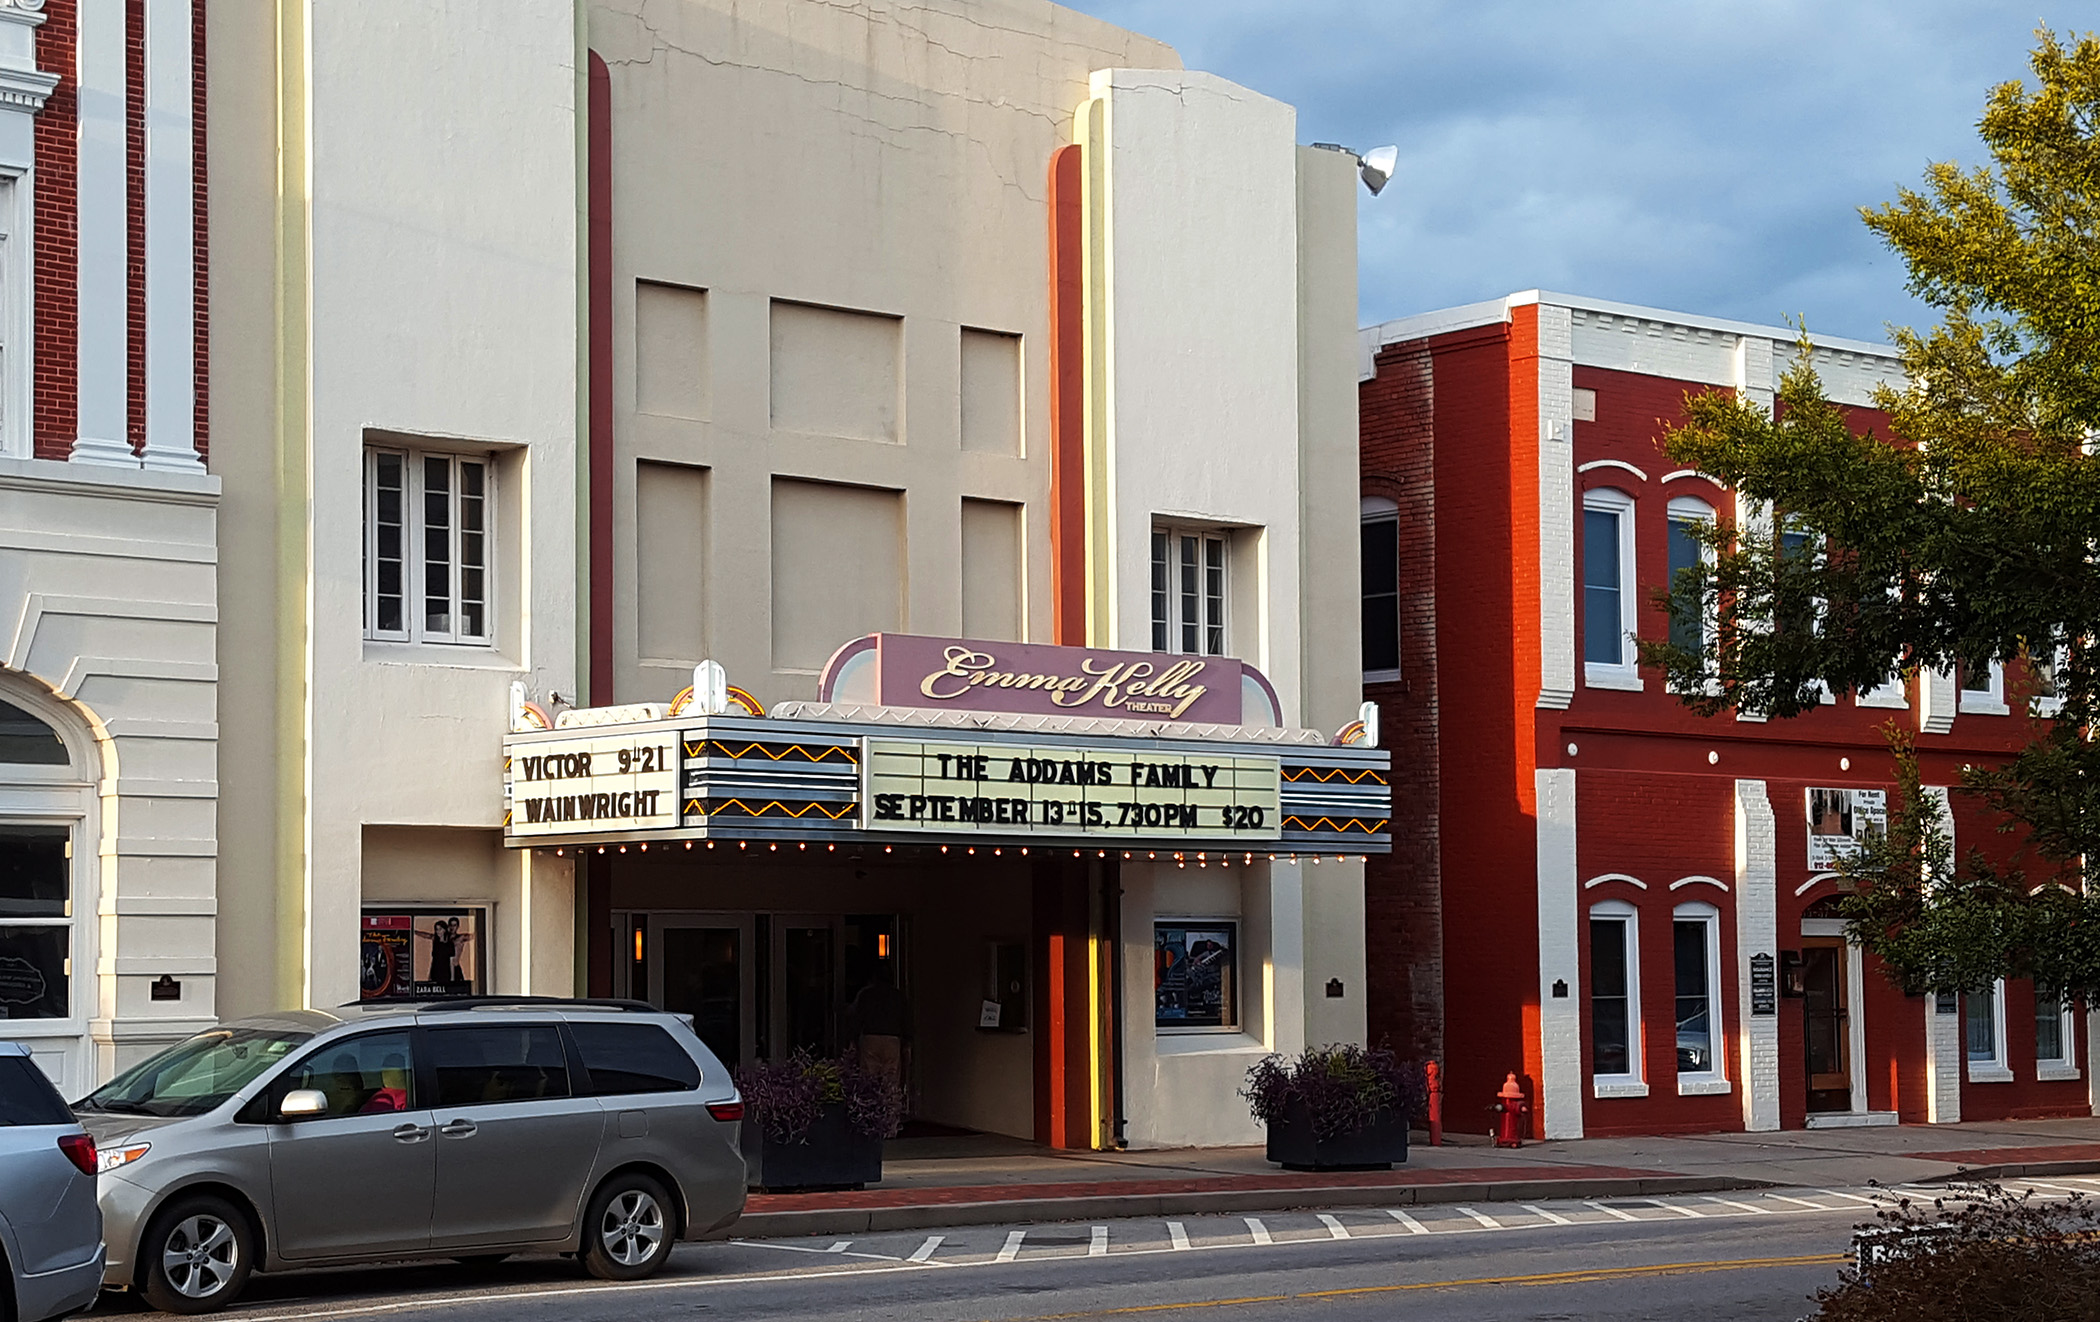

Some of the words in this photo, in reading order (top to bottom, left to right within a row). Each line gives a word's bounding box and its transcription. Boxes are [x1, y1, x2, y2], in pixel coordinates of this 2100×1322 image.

[920, 645, 1087, 699] Emma
[1051, 657, 1207, 719] Kelly
[1125, 701, 1172, 714] THEATER
[522, 752, 592, 781] VICTOR
[938, 754, 989, 781] THE
[1009, 757, 1112, 786] ADDAMS
[525, 789, 660, 823] WAINWRIGHT
[873, 793, 1028, 825] SEPTEMBER
[1222, 805, 1264, 830] $20
